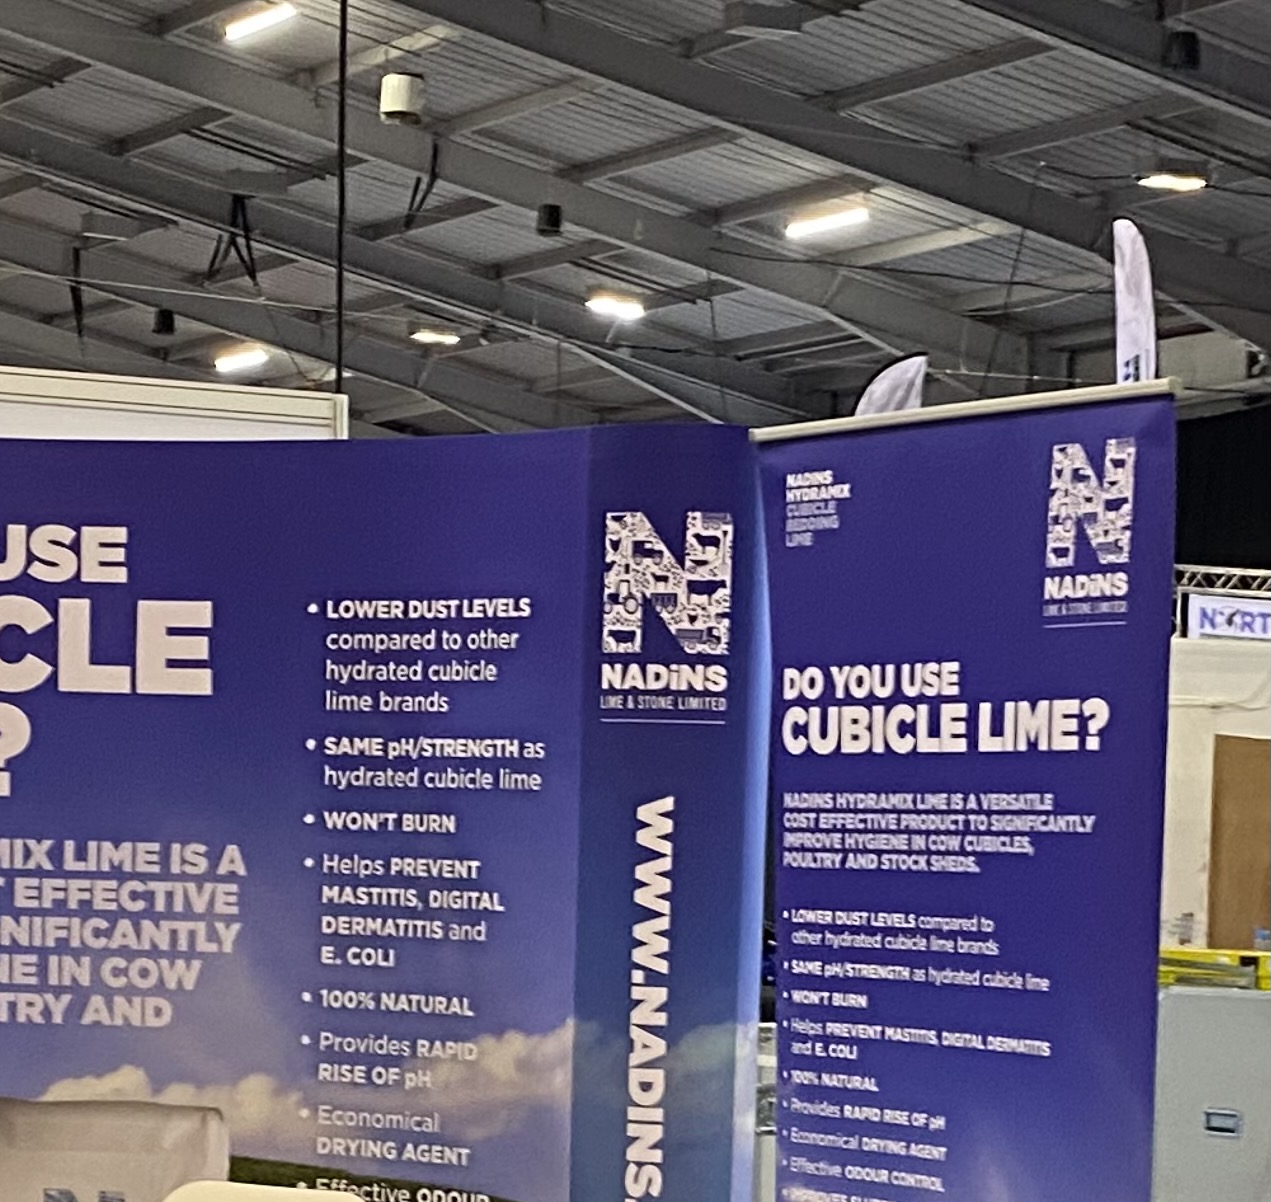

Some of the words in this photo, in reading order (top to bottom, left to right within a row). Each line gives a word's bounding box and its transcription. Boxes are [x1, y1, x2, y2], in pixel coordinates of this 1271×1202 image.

[327, 600, 403, 619] LOWER
[408, 599, 459, 618] DUST
[462, 598, 531, 617] LEVELS
[327, 629, 435, 652] compared
[442, 631, 462, 649] to
[467, 629, 520, 649] other
[326, 659, 423, 684] hydrated
[428, 660, 498, 681] cubicle
[783, 666, 824, 700] DO
[829, 664, 895, 699] YOU
[901, 661, 960, 697] USE
[325, 690, 373, 711] lime
[379, 691, 450, 712] brands
[600, 696, 624, 709] LIME
[637, 696, 674, 710] STONE
[678, 696, 727, 711] LIMITED
[782, 703, 968, 755] CUBICLE
[978, 698, 1110, 752] LIME?
[324, 737, 383, 756] SAME
[388, 736, 519, 760] pH/STRENGTH
[523, 742, 545, 759] as
[324, 766, 418, 790] hydrated
[424, 768, 493, 789] cubicle
[499, 768, 542, 790] lime
[323, 811, 397, 831] WON'T
[402, 814, 456, 833] BURN
[783, 813, 817, 828] COST
[819, 813, 898, 829] EFFECTIVE
[900, 814, 966, 830] PRODUCT
[968, 814, 989, 831] TO
[990, 814, 1096, 832] SIGNIFICANTLY
[62, 839, 161, 874] LIME
[170, 843, 210, 877] IS
[216, 845, 248, 878] A
[323, 854, 384, 878] Helps
[390, 858, 481, 879] PREVENT
[14, 878, 240, 915] EFFECTIVE
[321, 885, 423, 911] MASTITIS,
[428, 890, 505, 912] DIGITAL
[321, 916, 443, 939] DERMATITIS
[448, 920, 487, 941] and
[791, 909, 833, 923] LOWER
[835, 911, 869, 926] DUST
[870, 912, 916, 928] LEVELS
[320, 946, 342, 965] E.
[347, 947, 395, 967] COLI
[48, 954, 91, 987] IN
[99, 956, 203, 991] COW
[80, 994, 173, 1029] AND
[319, 989, 375, 1010] 100%
[380, 993, 475, 1016] NATURAL
[832, 992, 868, 1009] BURN
[319, 1031, 411, 1055] Provides
[416, 1039, 477, 1060] RAPID
[318, 1063, 367, 1083] RISE
[371, 1065, 401, 1085] OF
[404, 1069, 432, 1090] pH
[317, 1104, 440, 1133] Economical
[316, 1136, 397, 1160] DRYING
[402, 1144, 471, 1167] AGENT
